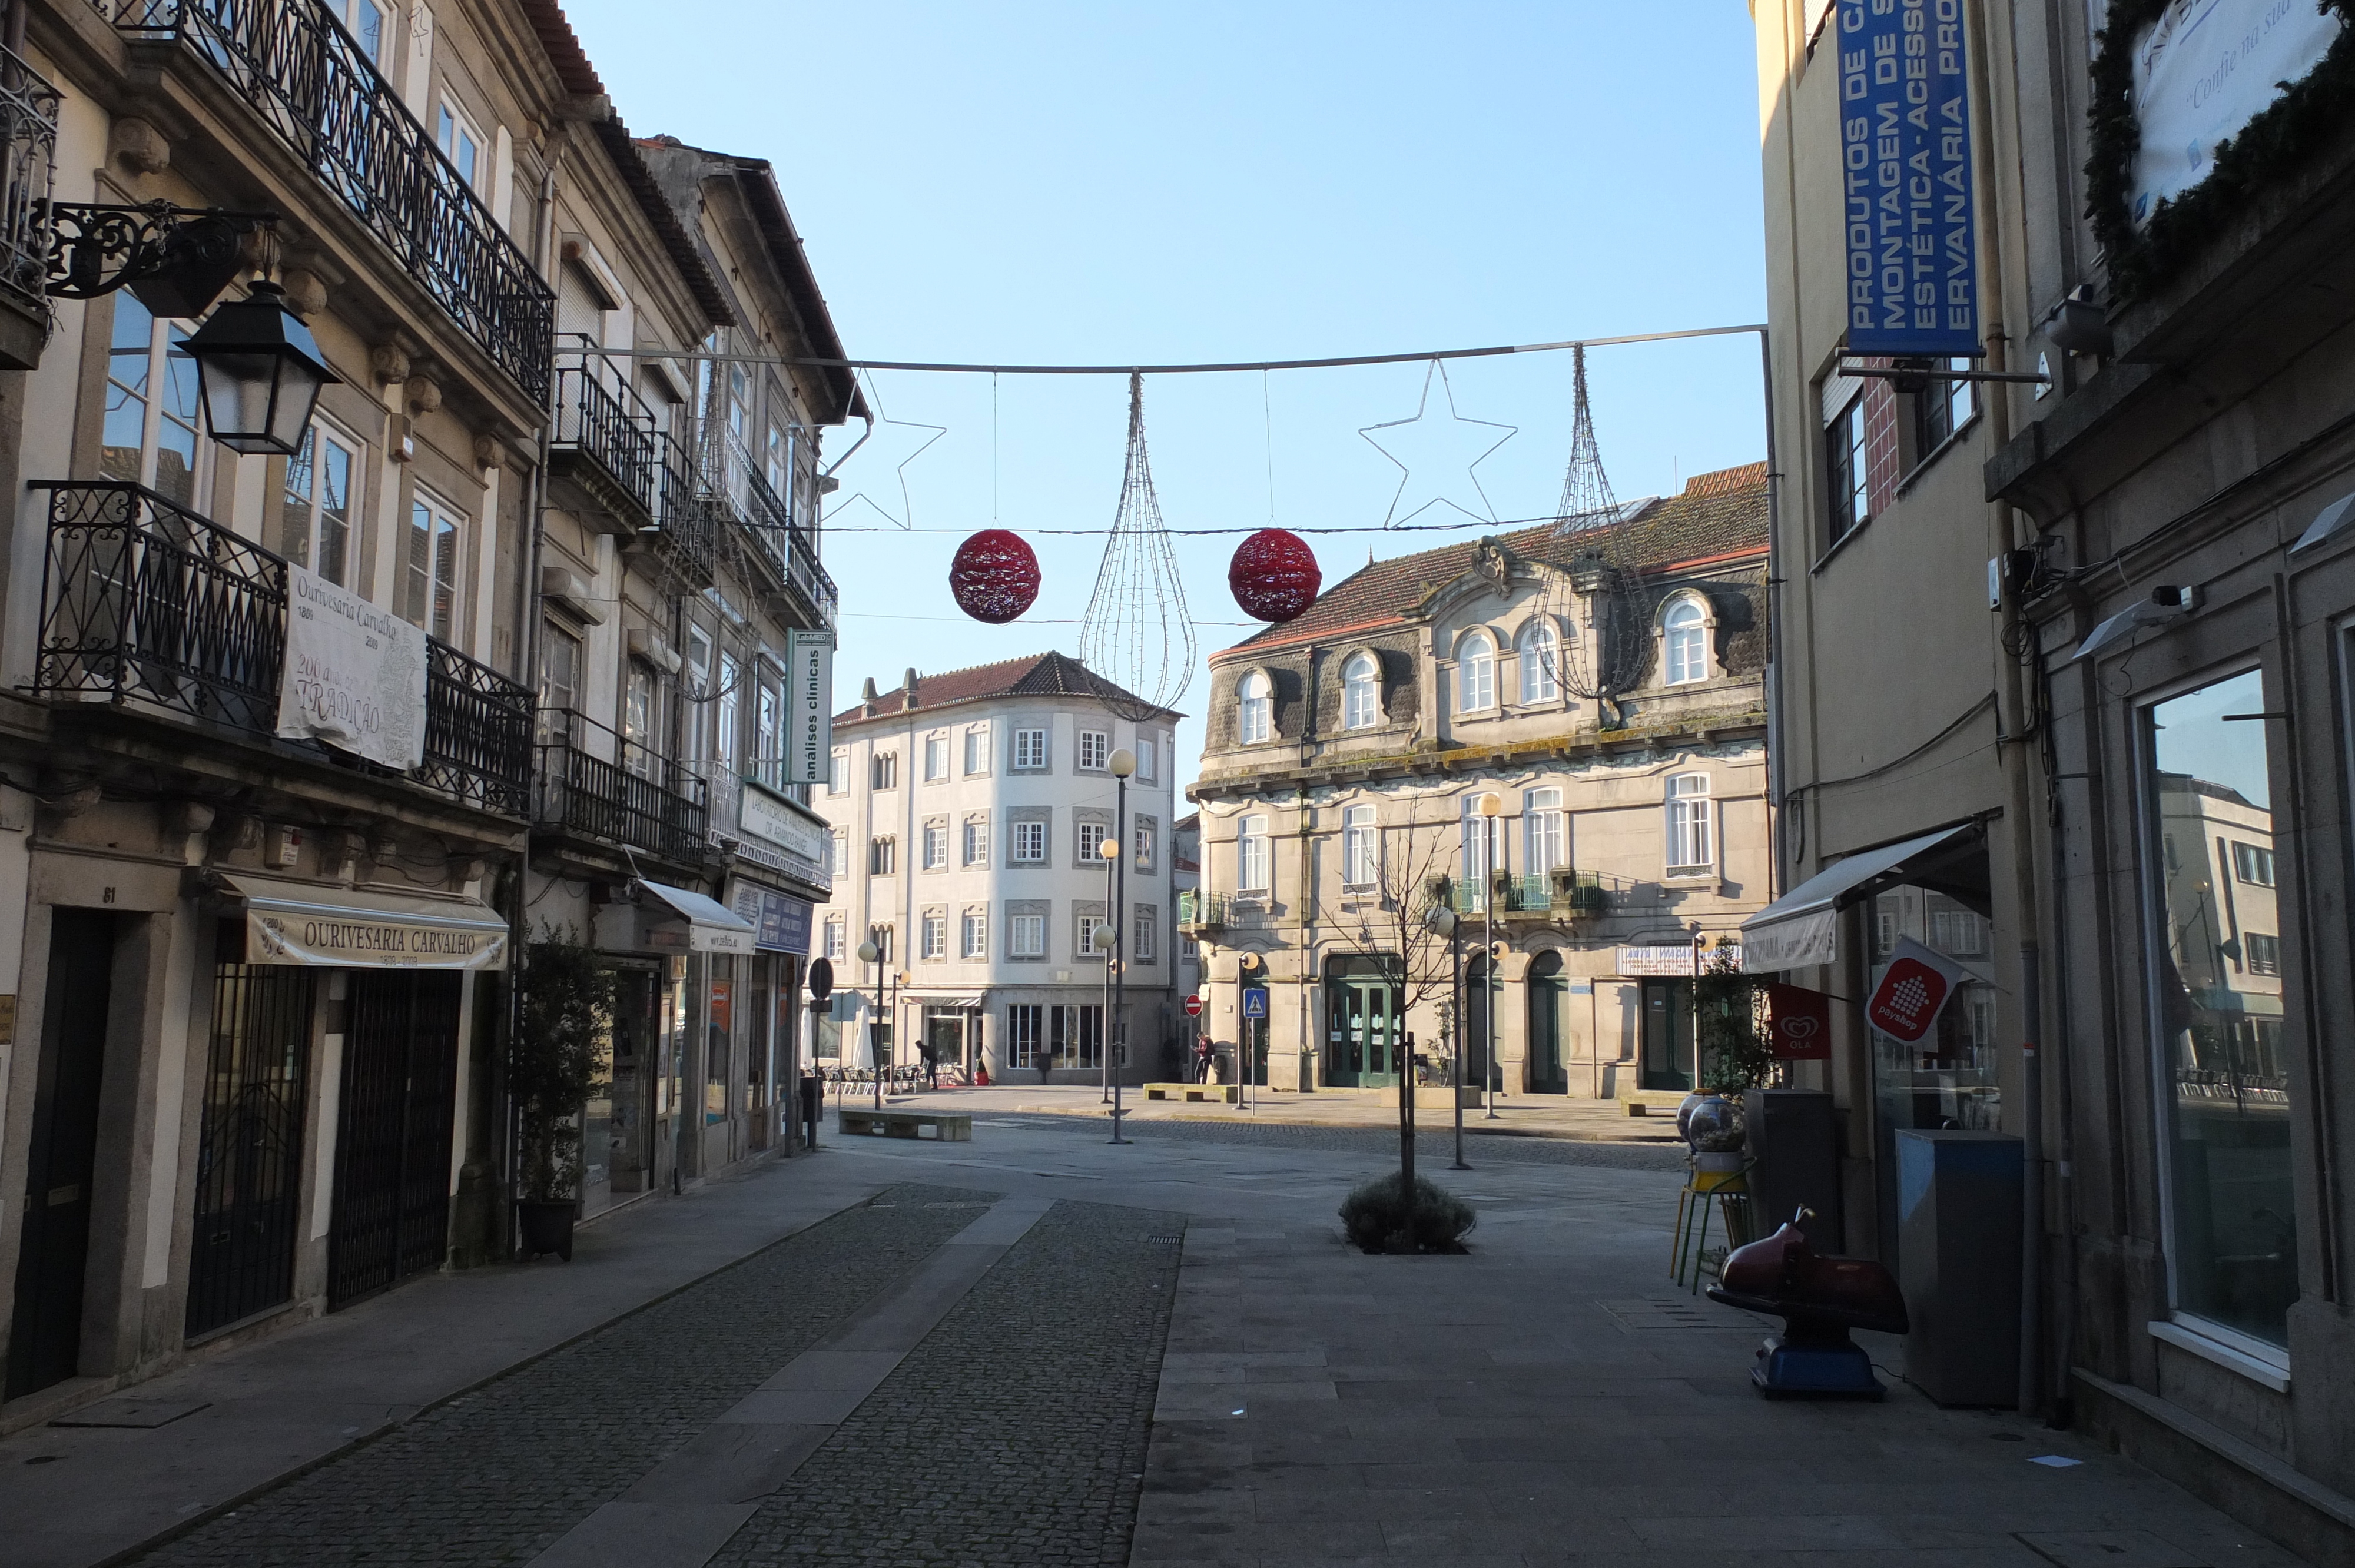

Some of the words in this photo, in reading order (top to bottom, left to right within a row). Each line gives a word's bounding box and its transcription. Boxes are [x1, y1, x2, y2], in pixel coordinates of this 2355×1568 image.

[1843, 0, 1865, 33] C
[2241, 25, 2259, 58] na
[1845, 49, 1868, 102] DE
[1873, 33, 1898, 85] DE
[1846, 117, 1875, 330] PRODUTOS
[1876, 101, 1906, 330] MONTAGEM
[1936, 95, 1971, 330] ERVANÁRIA
[1906, 149, 1936, 330] ESTÉTICA
[298, 576, 354, 620] Ourivesaria
[357, 604, 396, 640] Carvalho
[298, 606, 314, 620] 1809
[297, 653, 321, 678] 200
[366, 636, 379, 650] 2009
[806, 650, 819, 710] clínicas
[296, 679, 379, 734] TRADIÇÃO
[805, 715, 817, 780] análises
[102, 886, 116, 903] 81
[304, 922, 405, 952] OURIVESARIA
[412, 931, 475, 955] CARVALHO
[1878, 1005, 1918, 1031] payshop
